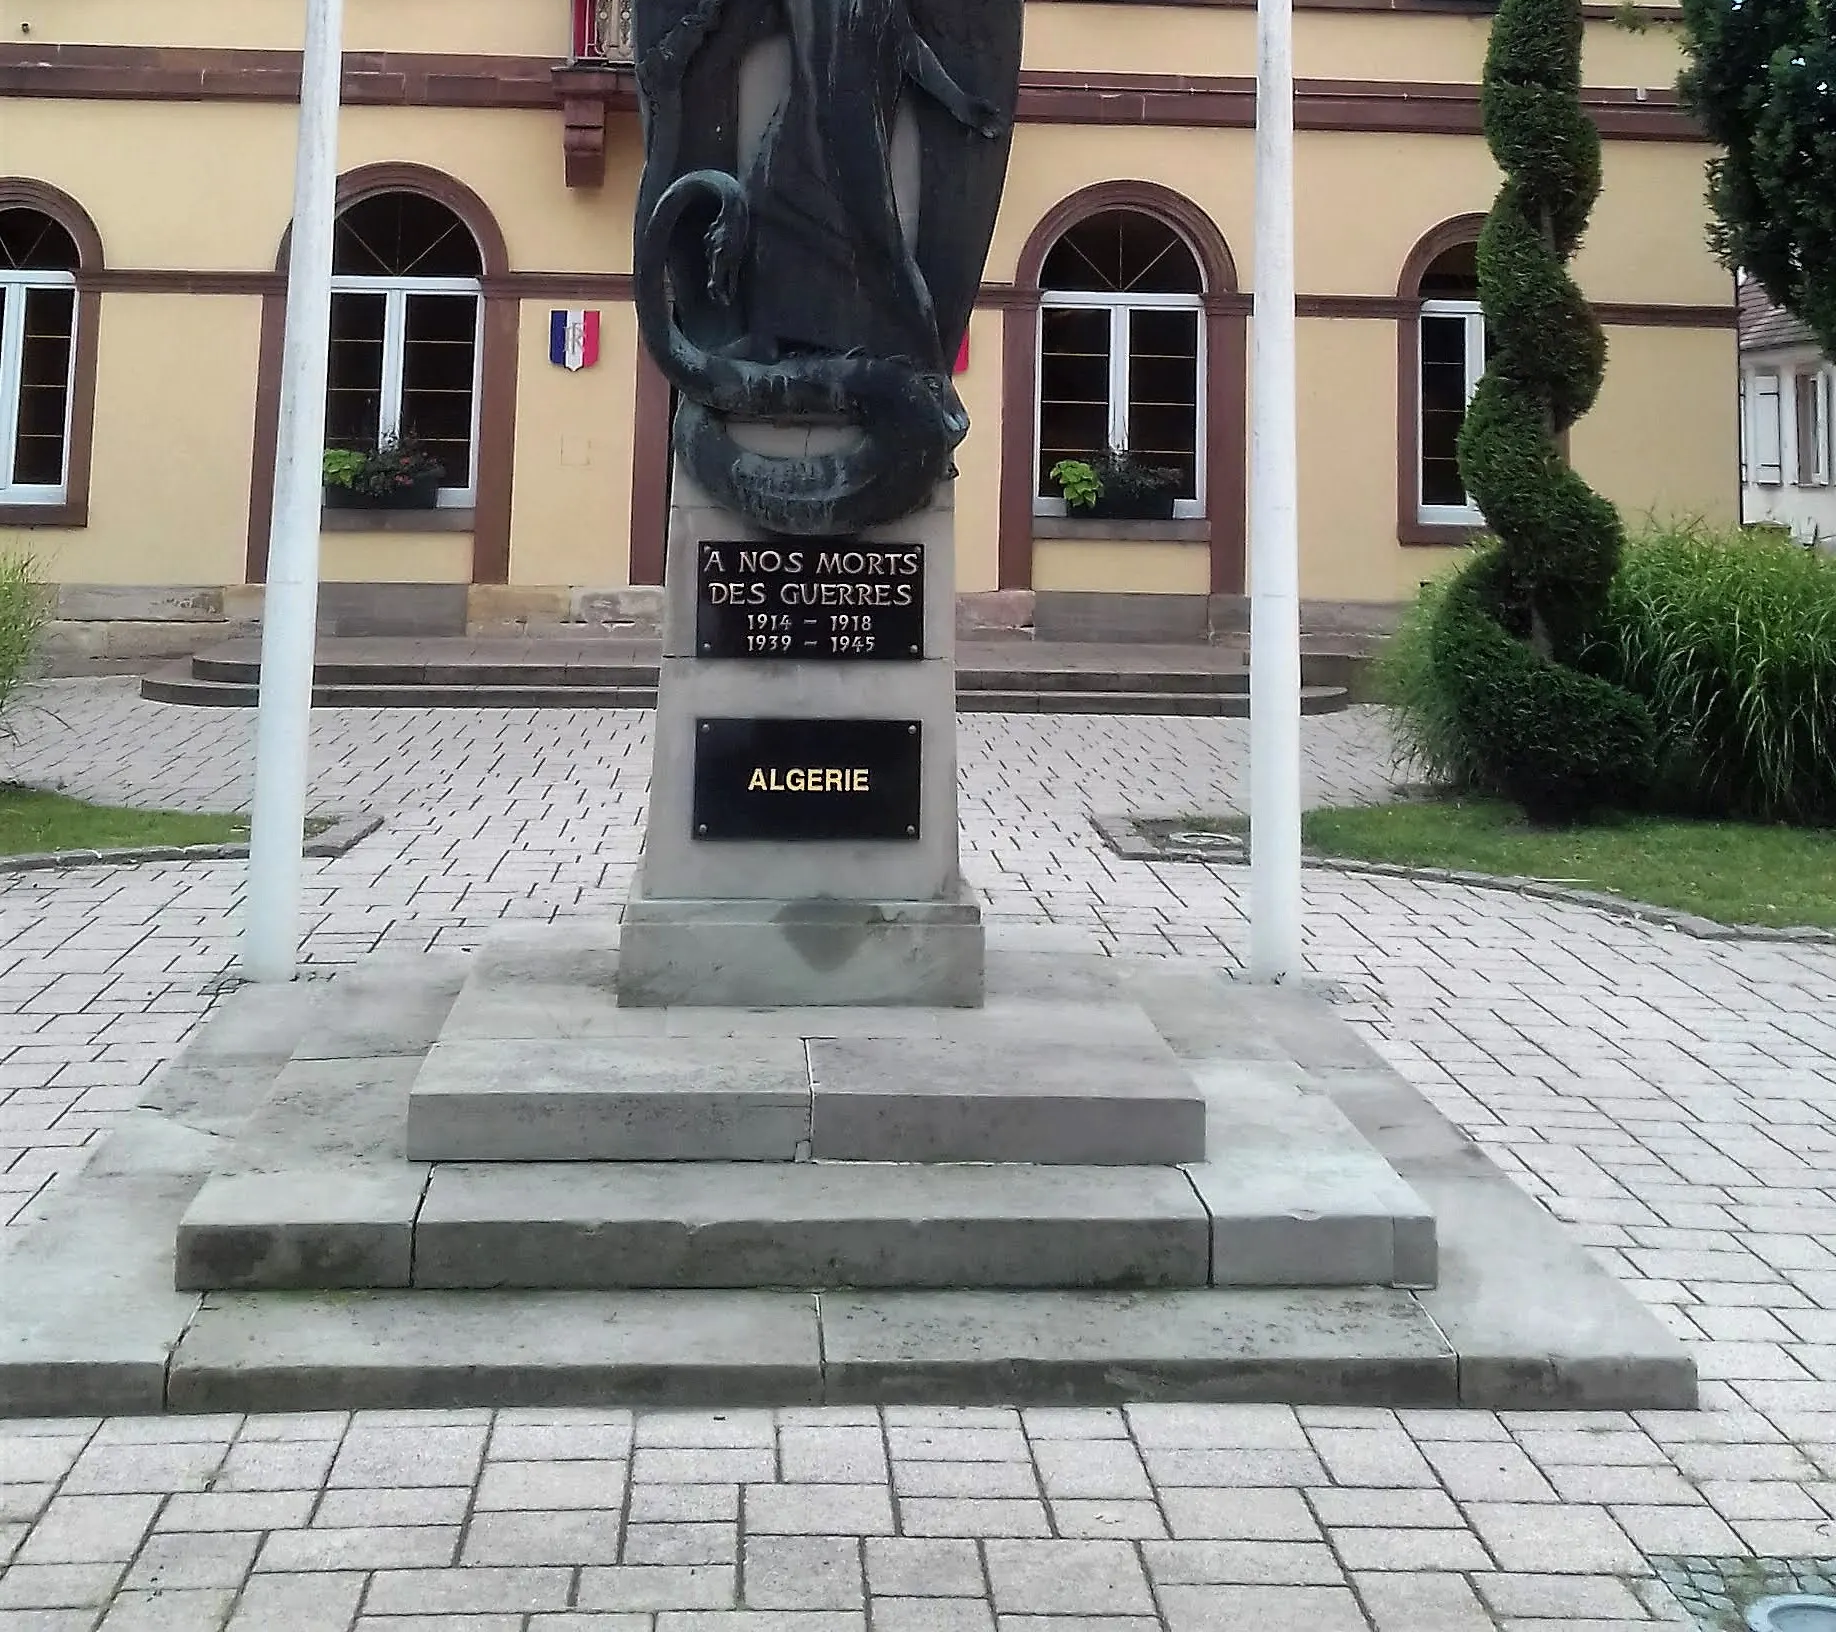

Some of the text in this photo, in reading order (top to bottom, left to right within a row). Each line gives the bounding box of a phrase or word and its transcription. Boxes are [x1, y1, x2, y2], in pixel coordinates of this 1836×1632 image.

[704, 550, 918, 575] A NOS MORTS
[708, 582, 912, 606] DES GUERRES
[747, 613, 792, 631] 1914
[831, 614, 872, 632] 1918
[747, 634, 792, 653] 1939
[831, 635, 875, 653] 1945
[747, 768, 869, 792] ALGERIE
